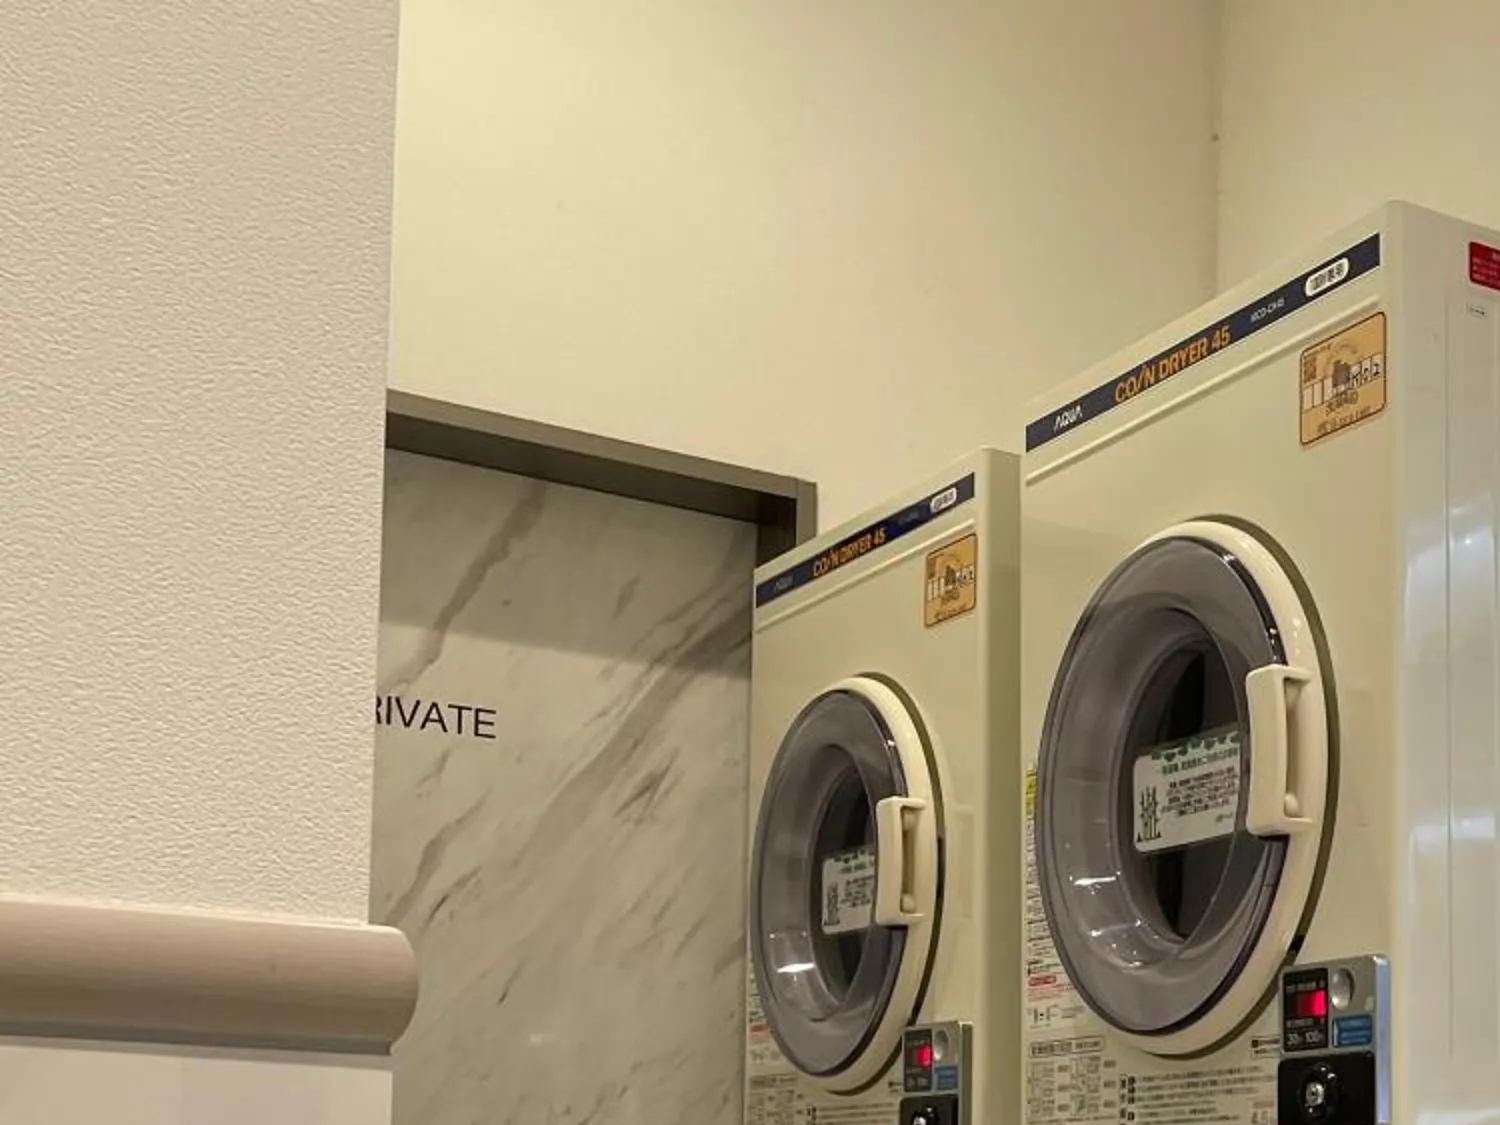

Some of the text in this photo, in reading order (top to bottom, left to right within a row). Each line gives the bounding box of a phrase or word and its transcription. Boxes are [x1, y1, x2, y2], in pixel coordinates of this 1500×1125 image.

[1053, 405, 1083, 431] AQUA
[1159, 337, 1208, 378] DRYER
[1212, 326, 1231, 348] 45
